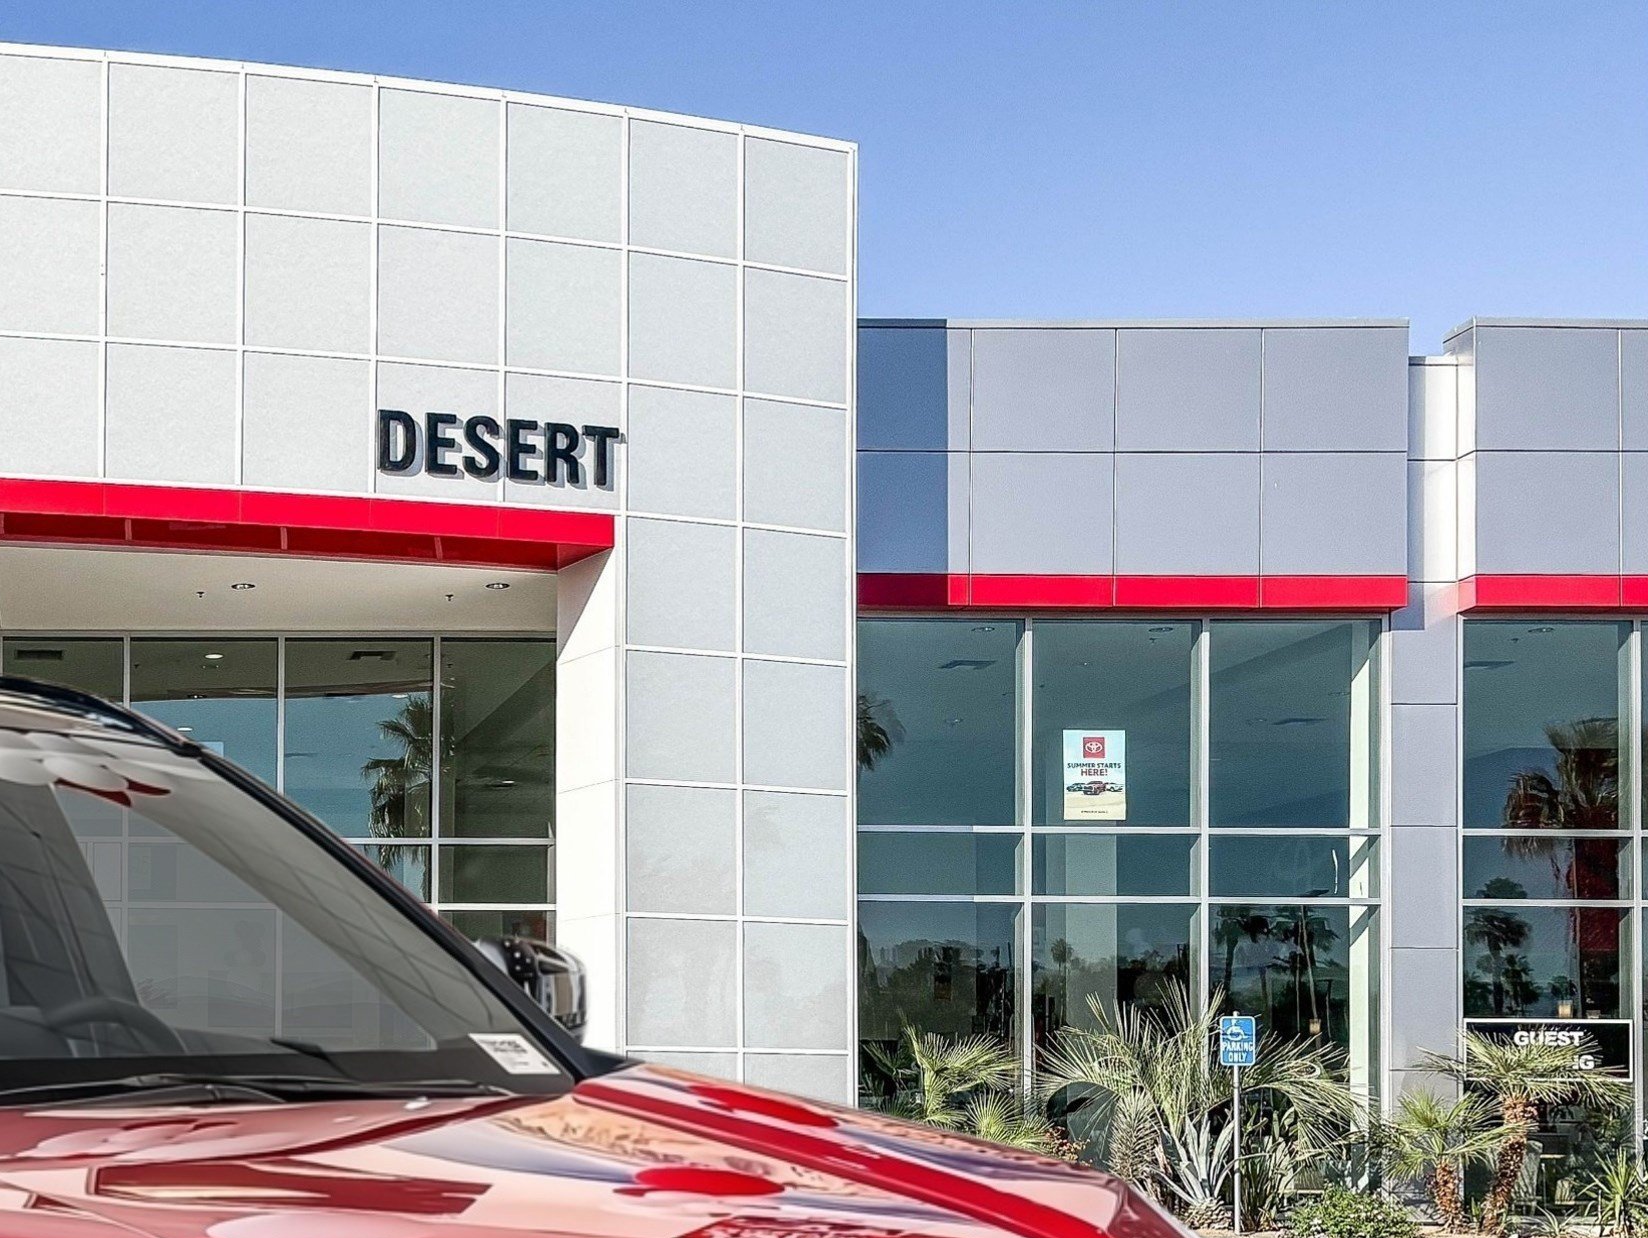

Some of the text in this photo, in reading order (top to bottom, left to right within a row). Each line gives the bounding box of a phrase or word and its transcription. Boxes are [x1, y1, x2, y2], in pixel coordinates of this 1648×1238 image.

[377, 409, 620, 487] DESERT
[1080, 768, 1108, 777] HERE!
[1513, 1030, 1585, 1047] GUEST
[1222, 1041, 1253, 1052] PARKING
[1228, 1051, 1248, 1062] ONLY
